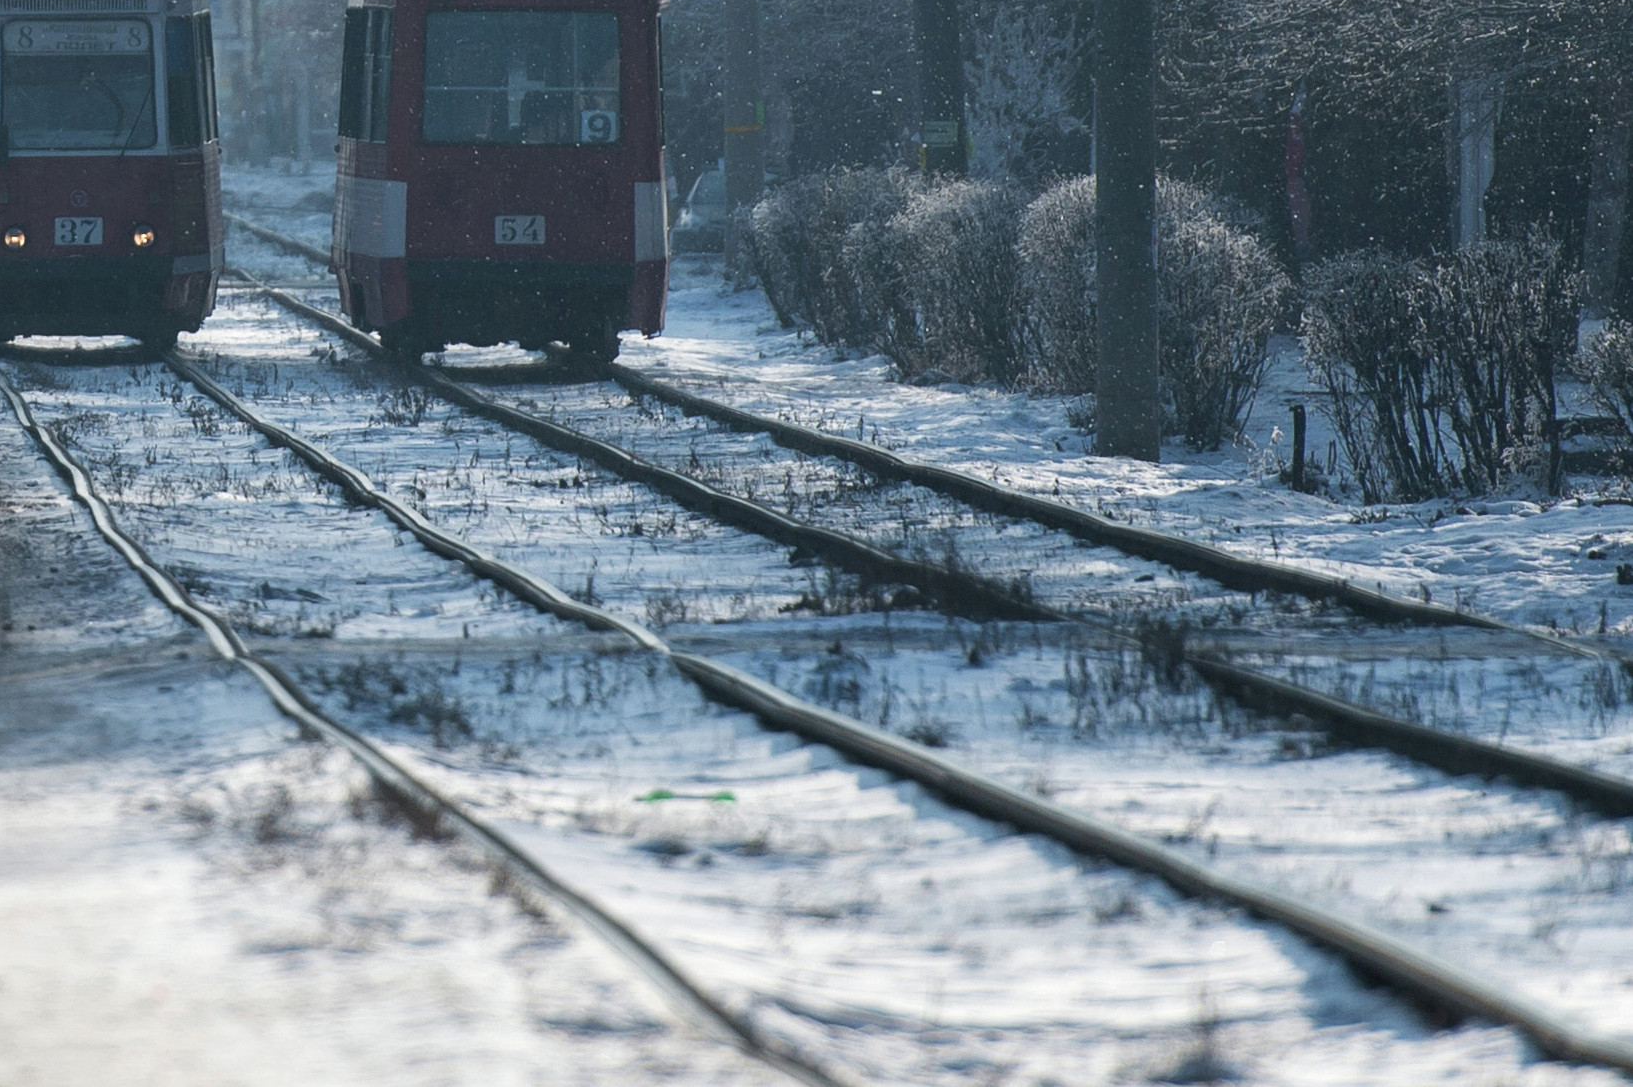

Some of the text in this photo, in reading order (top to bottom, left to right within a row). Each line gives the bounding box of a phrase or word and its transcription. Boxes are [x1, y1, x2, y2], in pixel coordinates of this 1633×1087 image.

[18, 25, 34, 49] 8
[127, 26, 142, 48] 8
[588, 113, 612, 143] 9
[61, 219, 98, 244] 37
[502, 219, 539, 242] 54
